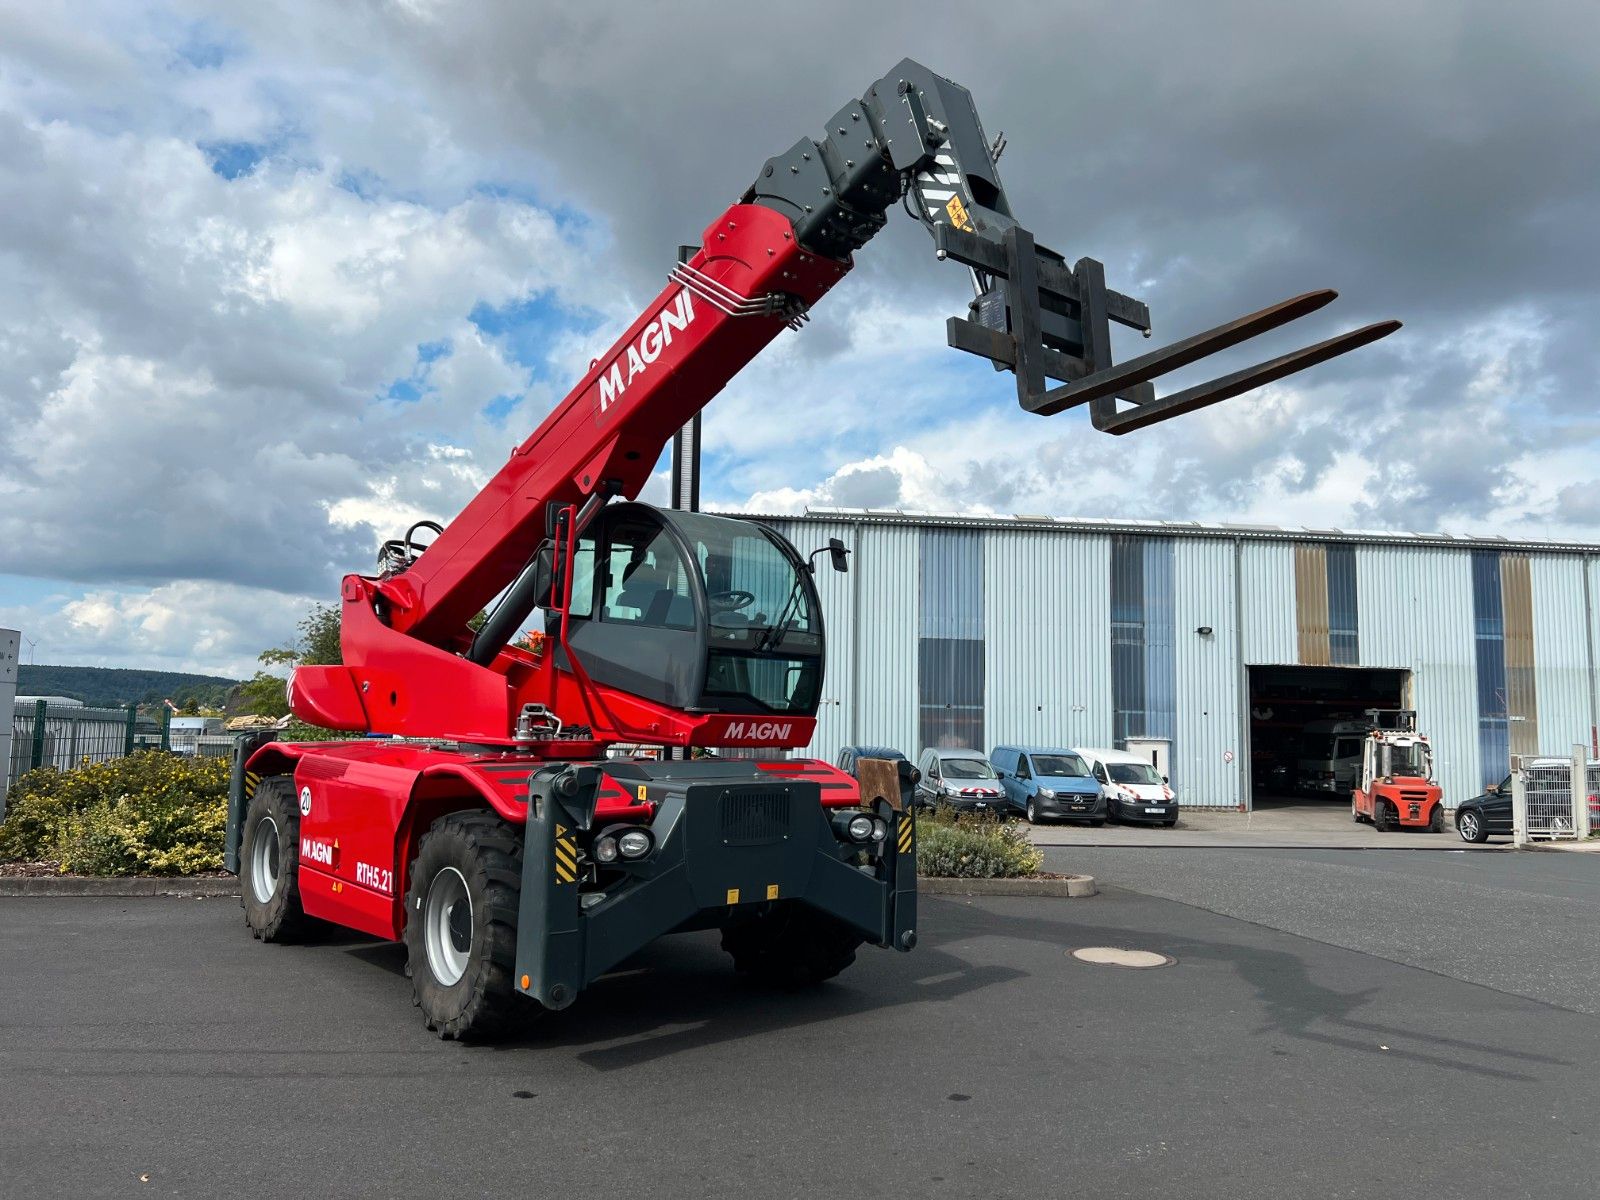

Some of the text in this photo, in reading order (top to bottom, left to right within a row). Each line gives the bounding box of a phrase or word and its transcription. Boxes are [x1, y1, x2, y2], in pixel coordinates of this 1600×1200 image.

[599, 286, 695, 413] MAGNI
[724, 722, 792, 740] MAGNI
[302, 791, 310, 811] 20
[302, 838, 332, 865] MAGNI
[356, 861, 393, 893] RTH5.21
